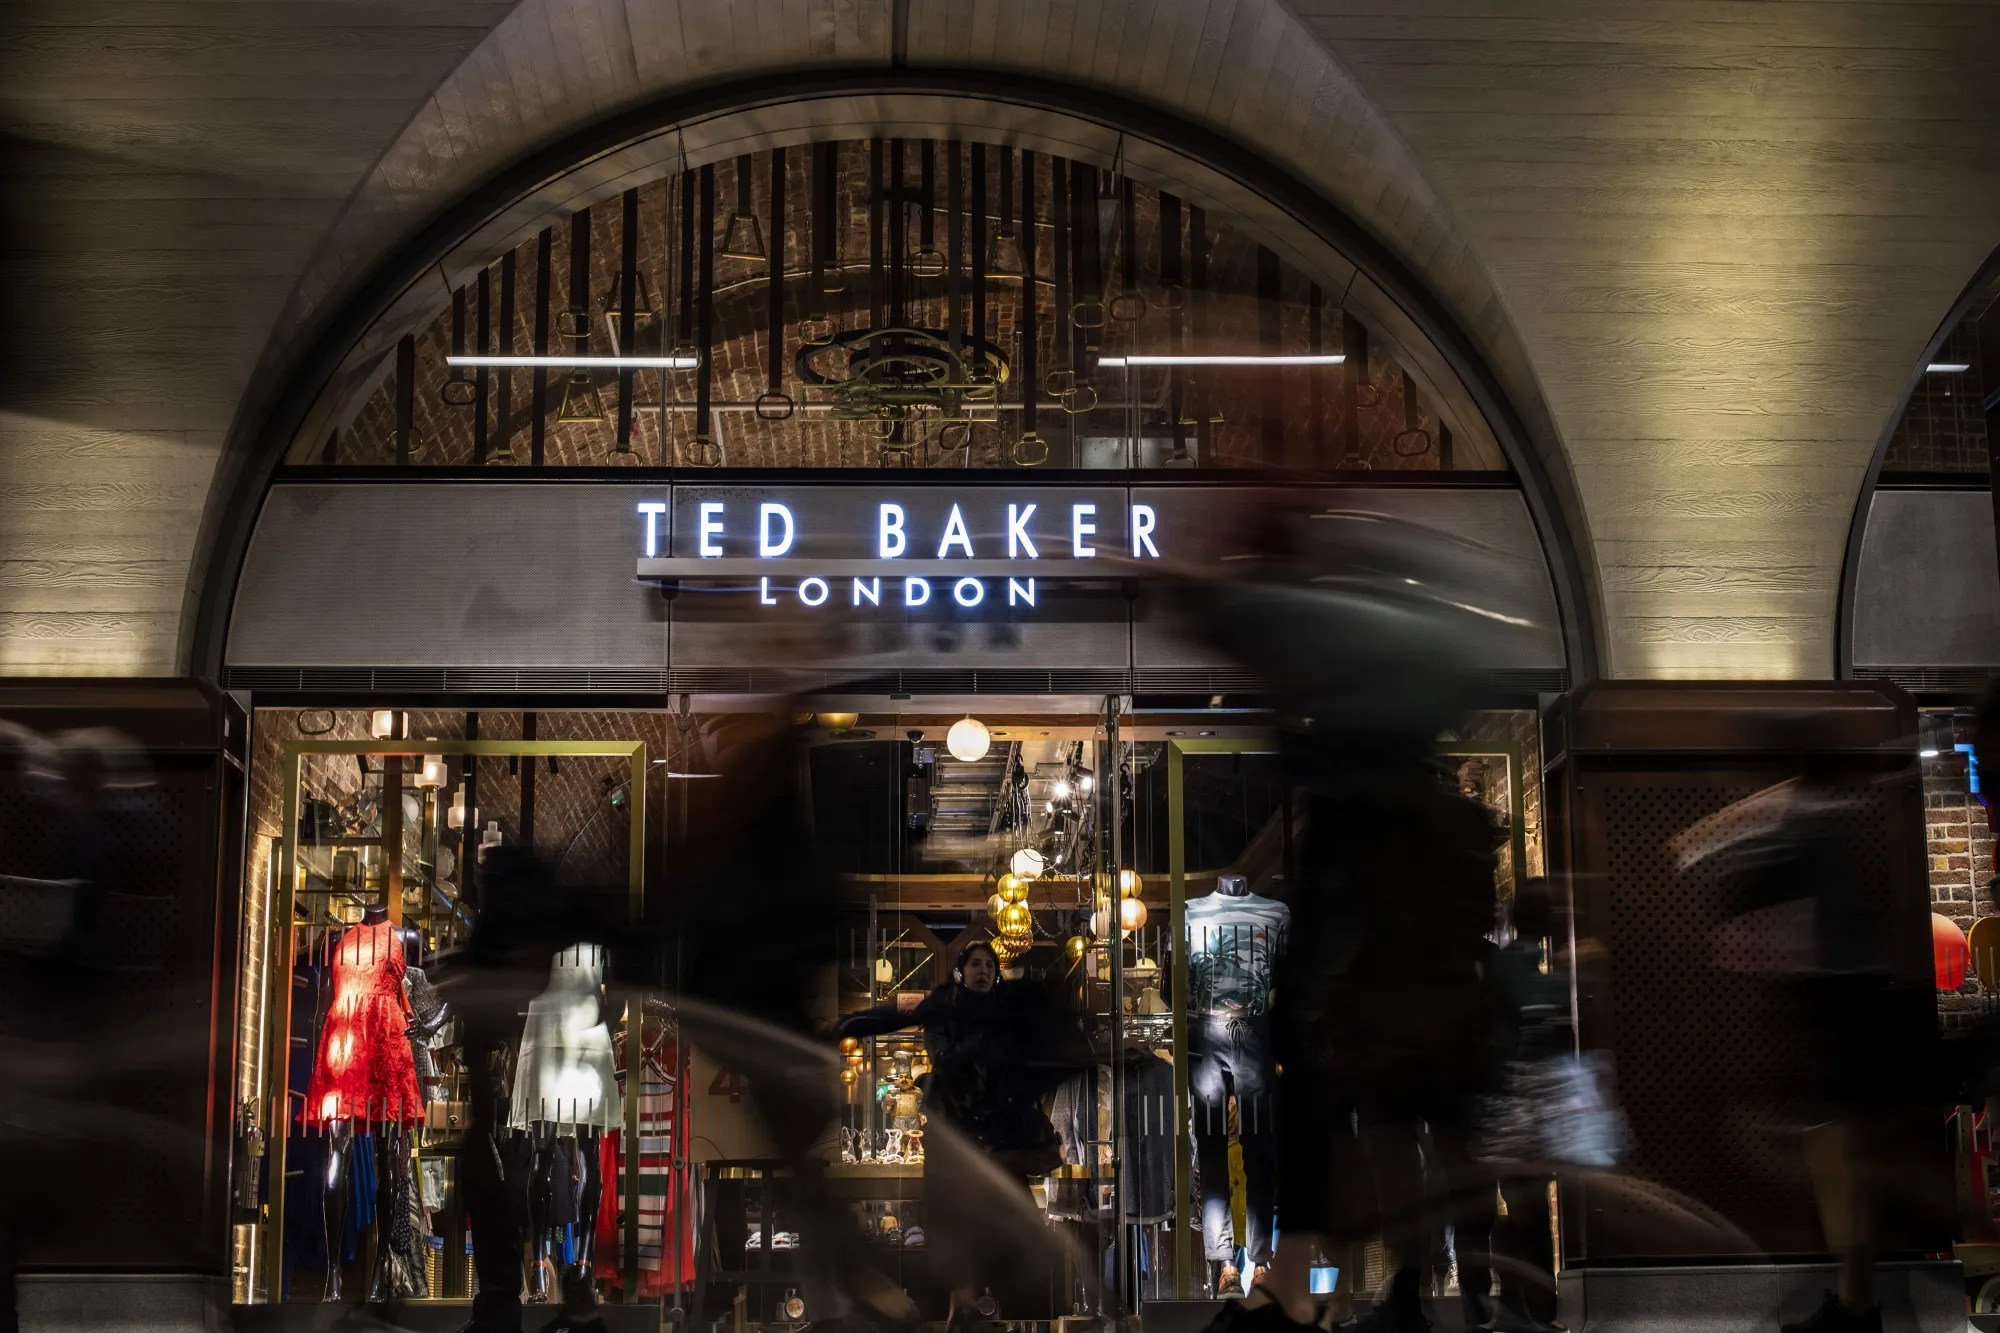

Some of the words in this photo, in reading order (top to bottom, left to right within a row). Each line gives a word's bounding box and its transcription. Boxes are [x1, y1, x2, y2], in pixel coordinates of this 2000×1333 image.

[637, 503, 793, 557] TED
[879, 503, 1159, 558] BAKER
[761, 577, 1036, 606] LONDON
